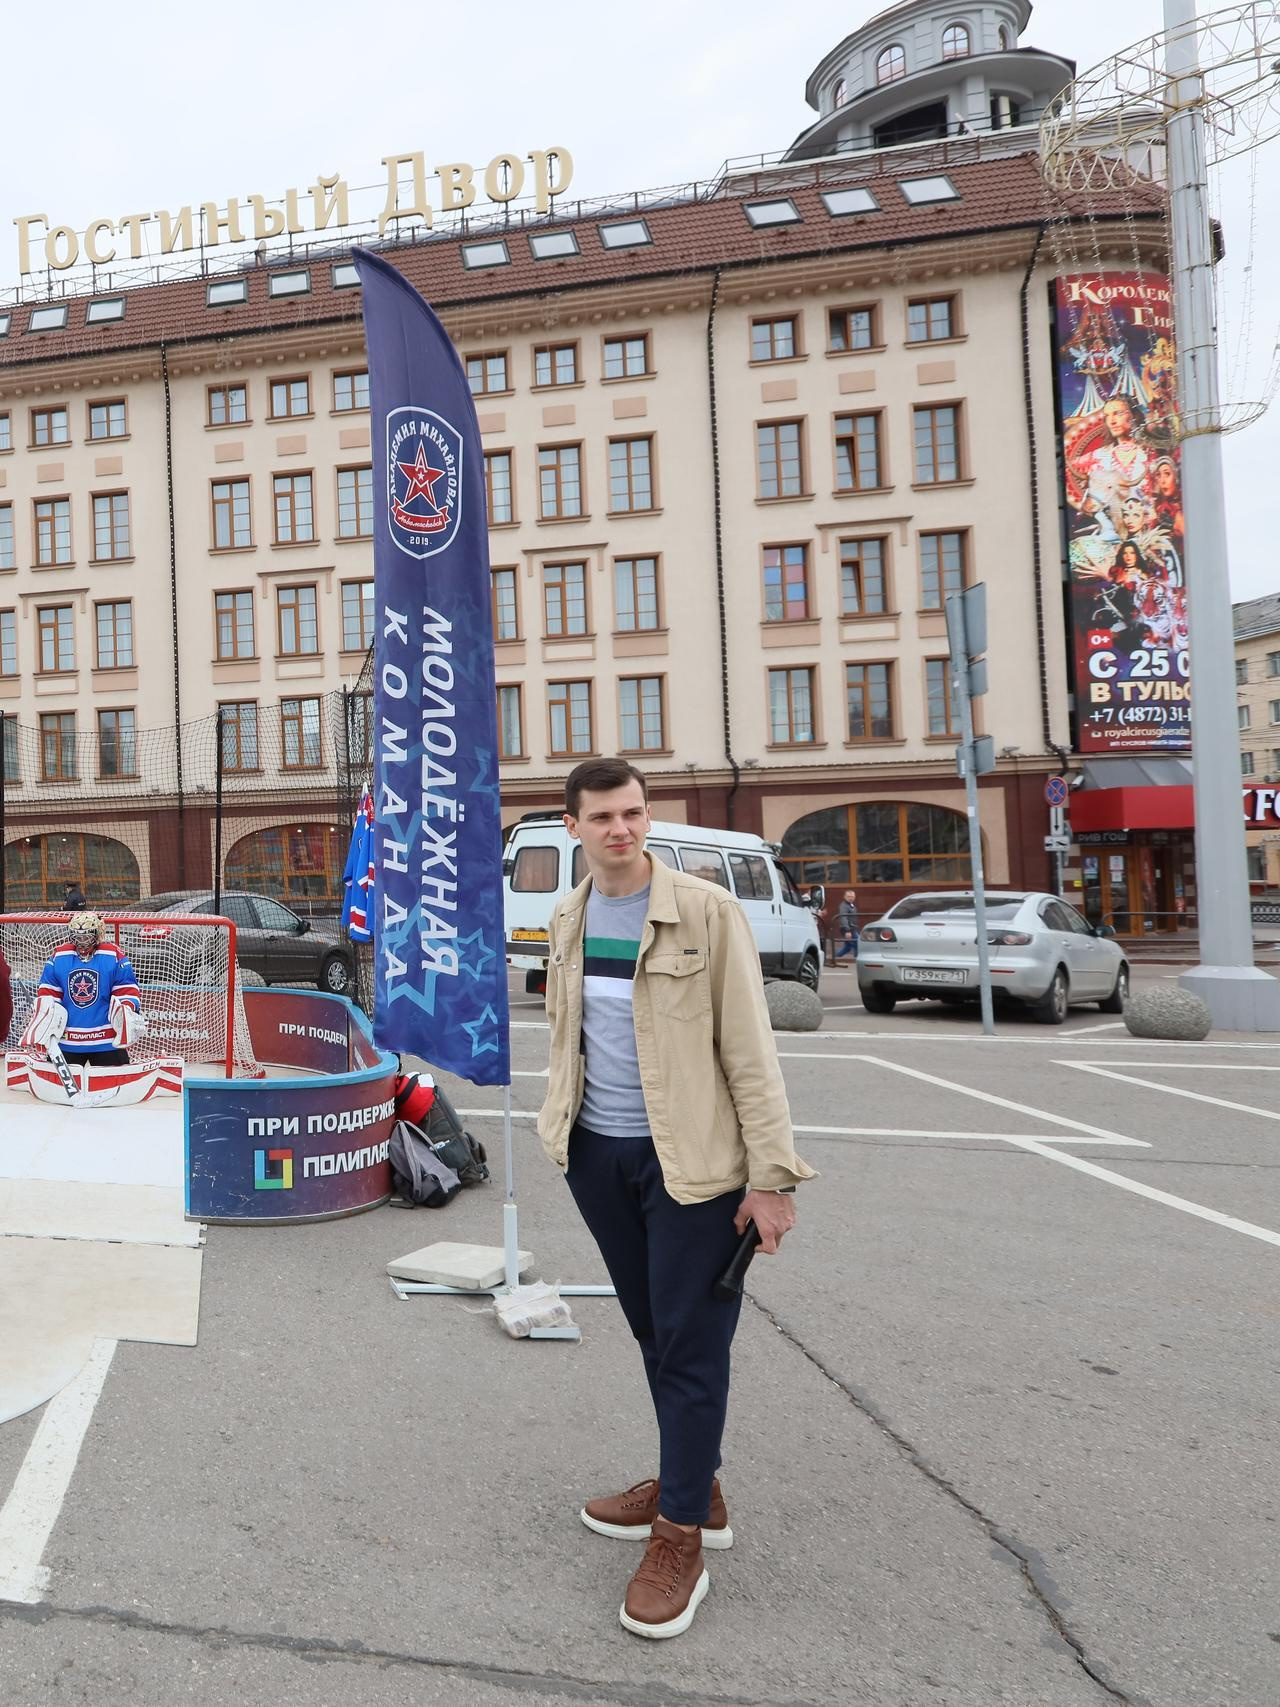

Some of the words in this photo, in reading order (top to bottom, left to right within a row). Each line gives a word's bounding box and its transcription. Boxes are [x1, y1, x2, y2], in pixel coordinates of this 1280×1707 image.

[13, 171, 350, 275] Гостиный
[378, 145, 575, 236] Двор
[390, 420, 417, 495] АКАДЕМИЯ
[420, 420, 458, 509] МИХАЙЛОВА
[1088, 651, 1118, 678] С
[1129, 650, 1170, 677] 25
[1090, 682, 1112, 703] В
[1089, 708, 1114, 722] +7
[1118, 706, 1167, 725] (4872)
[381, 604, 409, 981] КОМАНДА
[421, 605, 466, 976] МОЛОДЁЖНАЯ
[1078, 833, 1101, 842] РИВ
[1103, 831, 1128, 842] ГОШ
[69, 1032, 106, 1040] ПОЛИПЛАСТ
[279, 1023, 305, 1035] ПРИ
[248, 1117, 300, 1136] ПРИ
